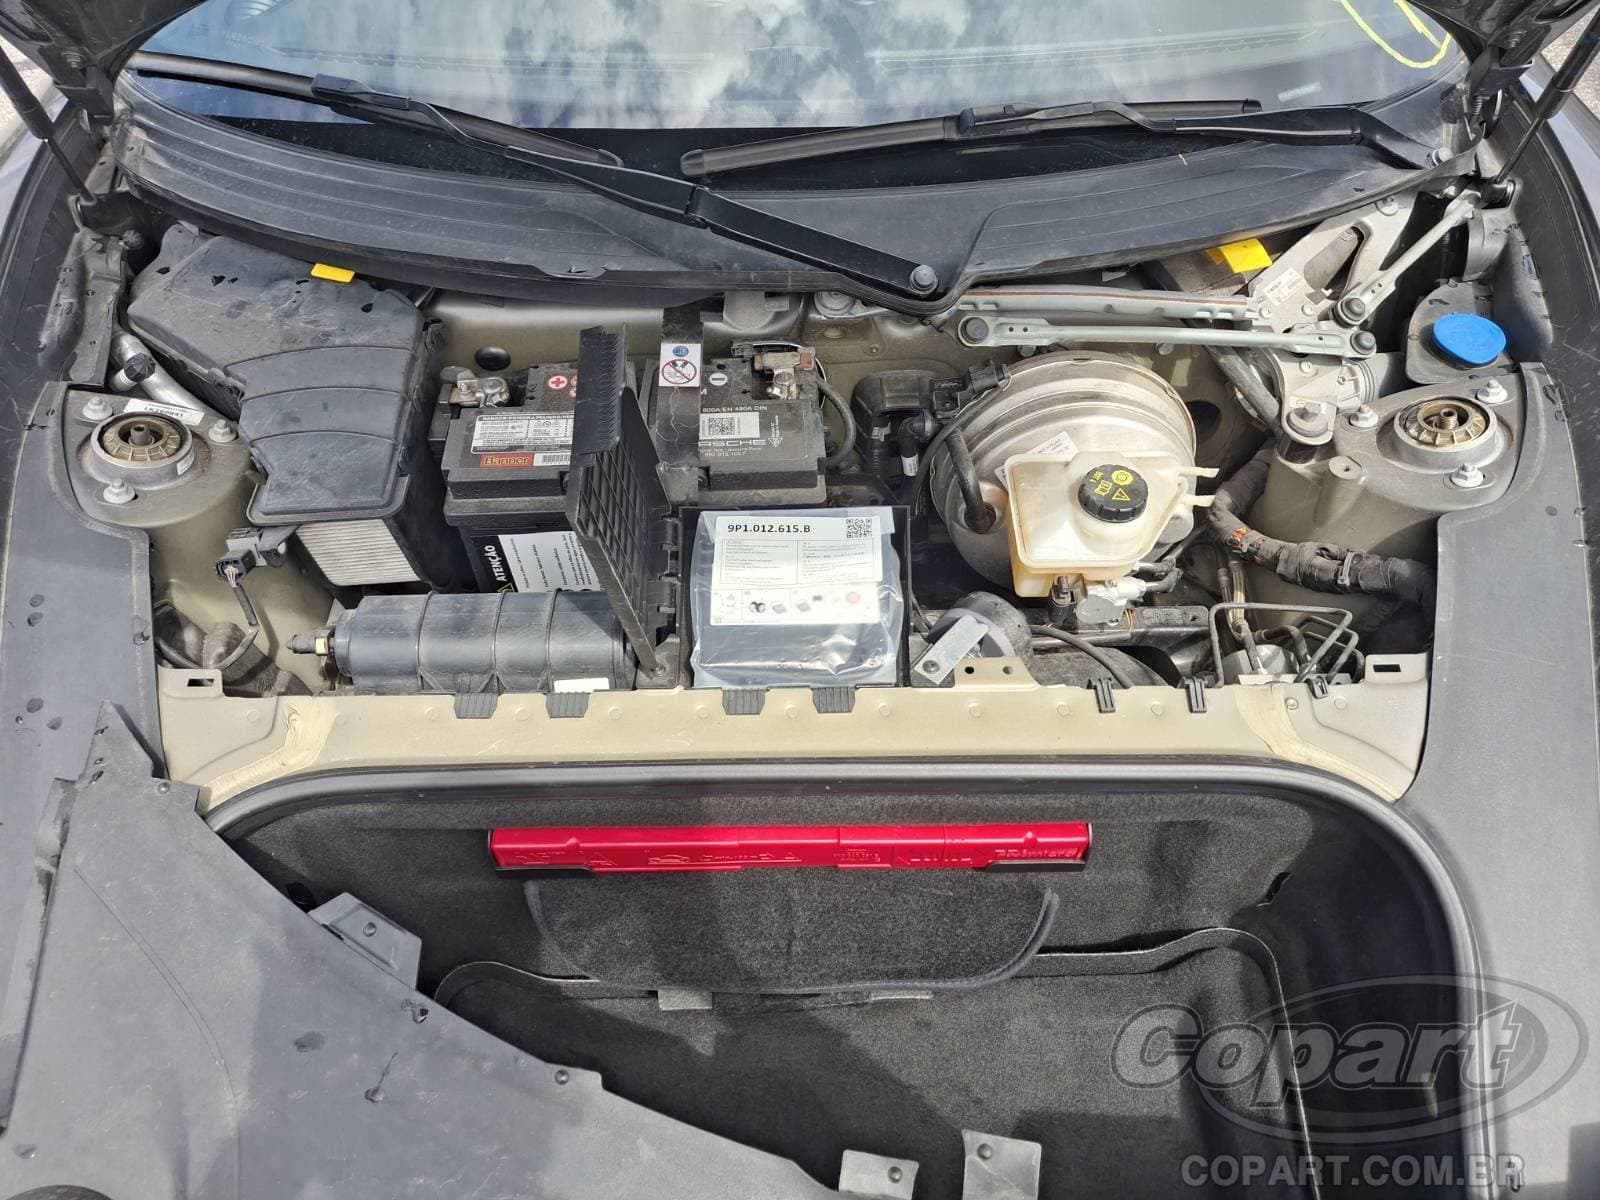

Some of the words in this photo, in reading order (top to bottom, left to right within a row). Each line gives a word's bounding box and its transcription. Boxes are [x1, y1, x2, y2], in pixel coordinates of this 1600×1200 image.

[698, 439, 767, 447] RSCHE
[484, 456, 528, 466] Banner
[727, 524, 811, 534] 9P1.012.615.B
[484, 545, 507, 582] ATENÇÃO
